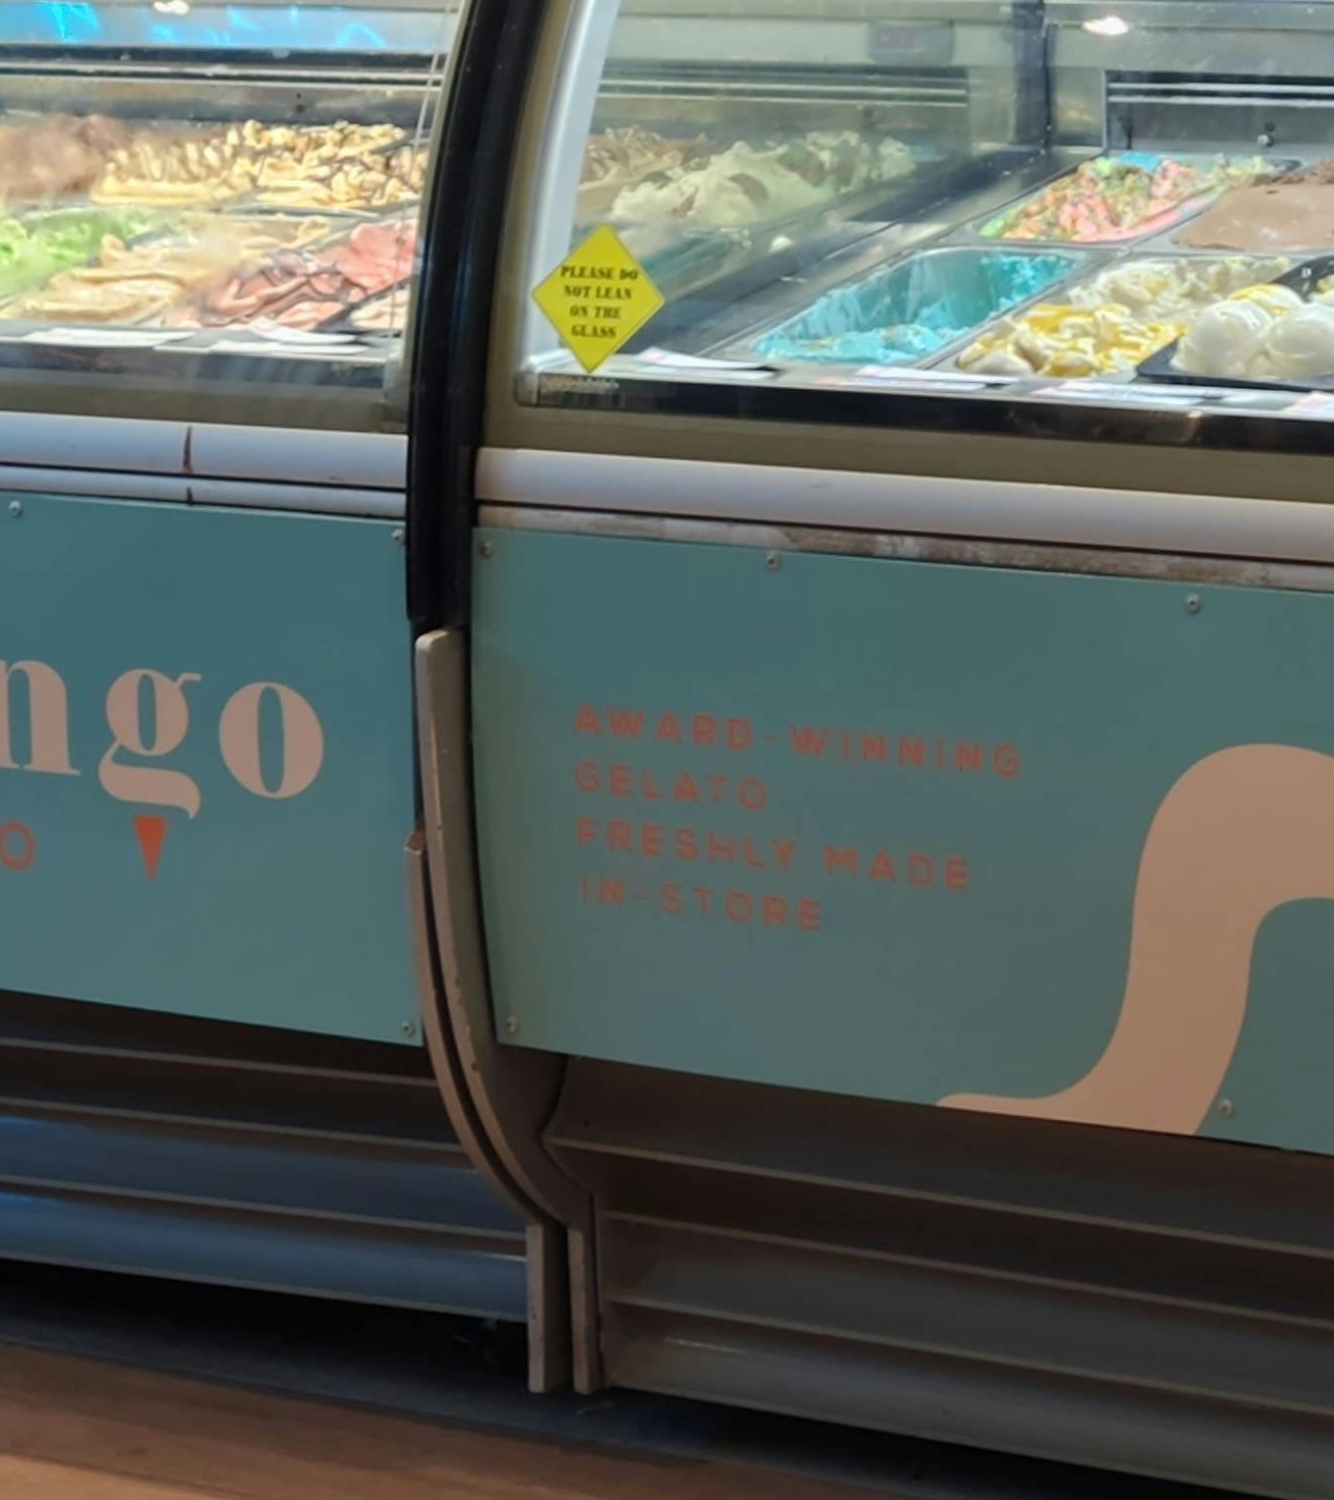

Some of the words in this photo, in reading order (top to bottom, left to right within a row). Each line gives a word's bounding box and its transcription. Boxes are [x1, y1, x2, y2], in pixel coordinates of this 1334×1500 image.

[559, 265, 614, 280] PLEASE
[619, 267, 639, 281] DO
[564, 285, 591, 298] NOT
[595, 285, 632, 300] LEAN
[569, 305, 588, 319] ON
[593, 306, 621, 320] THE
[571, 324, 617, 339] GLASS
[575, 703, 1022, 779] AWARD-WINNING
[575, 760, 767, 810] GELATO
[577, 816, 796, 877] FRESHLY
[824, 845, 969, 890] MADE
[582, 875, 822, 932] IN-STORE
